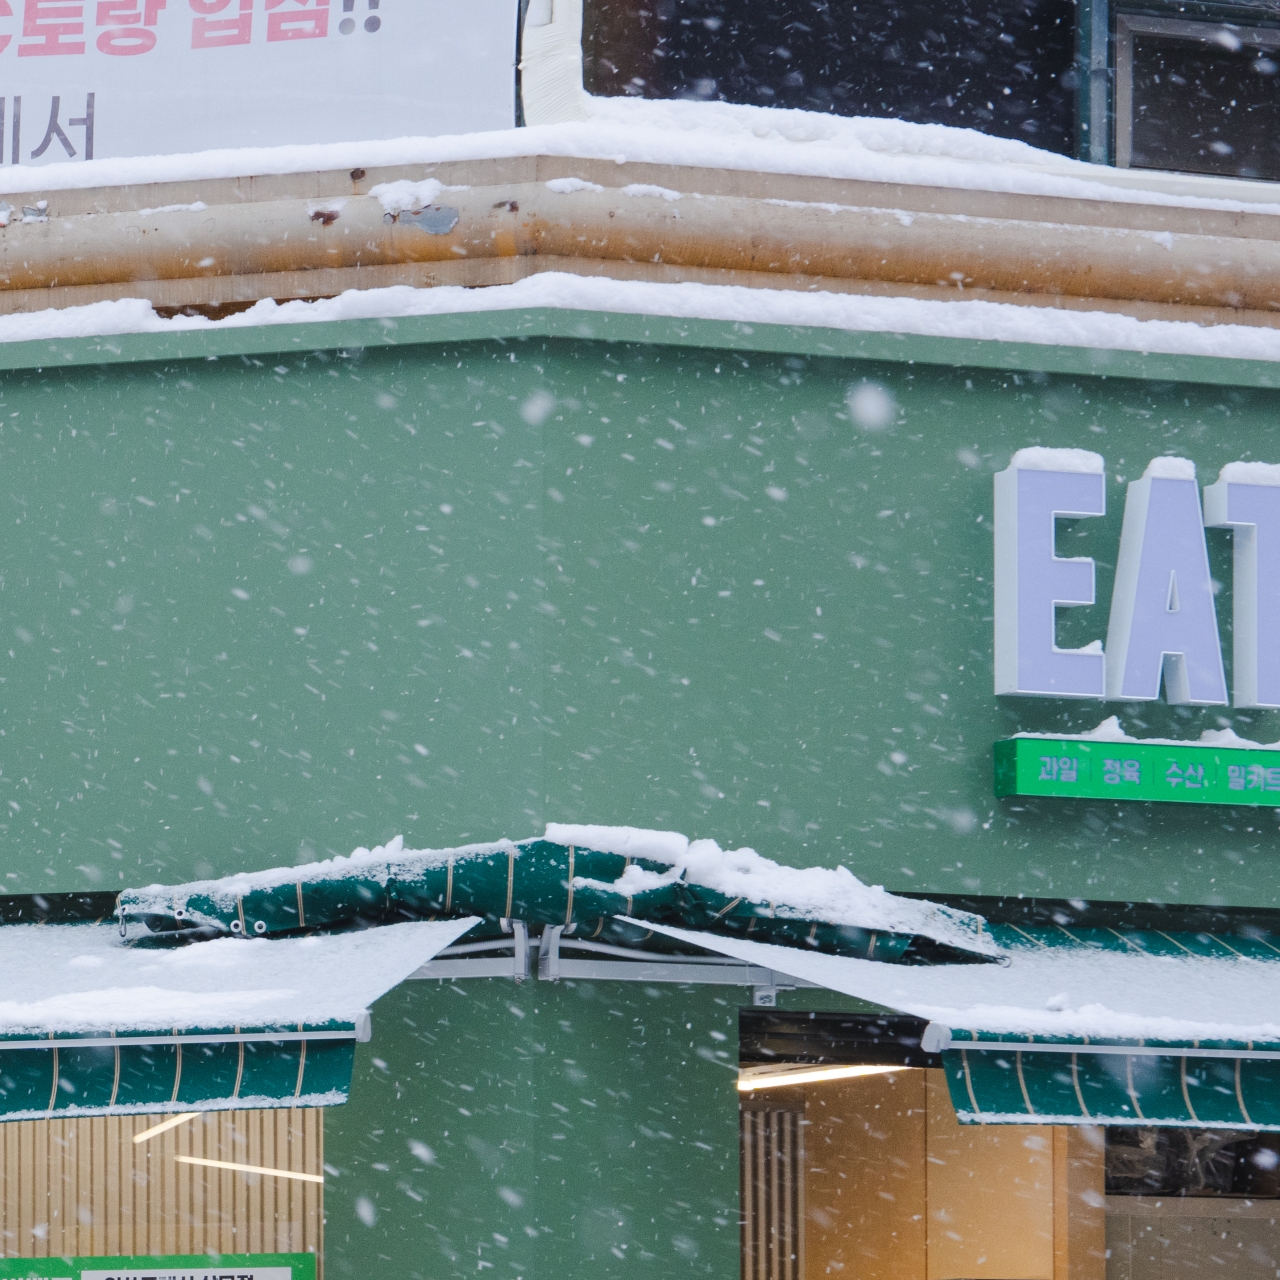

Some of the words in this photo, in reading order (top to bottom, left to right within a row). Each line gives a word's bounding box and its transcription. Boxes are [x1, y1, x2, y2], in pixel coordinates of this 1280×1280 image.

[1039, 756, 1079, 783] 과일
[1102, 758, 1141, 785] 정육
[1165, 762, 1205, 789] 수산
